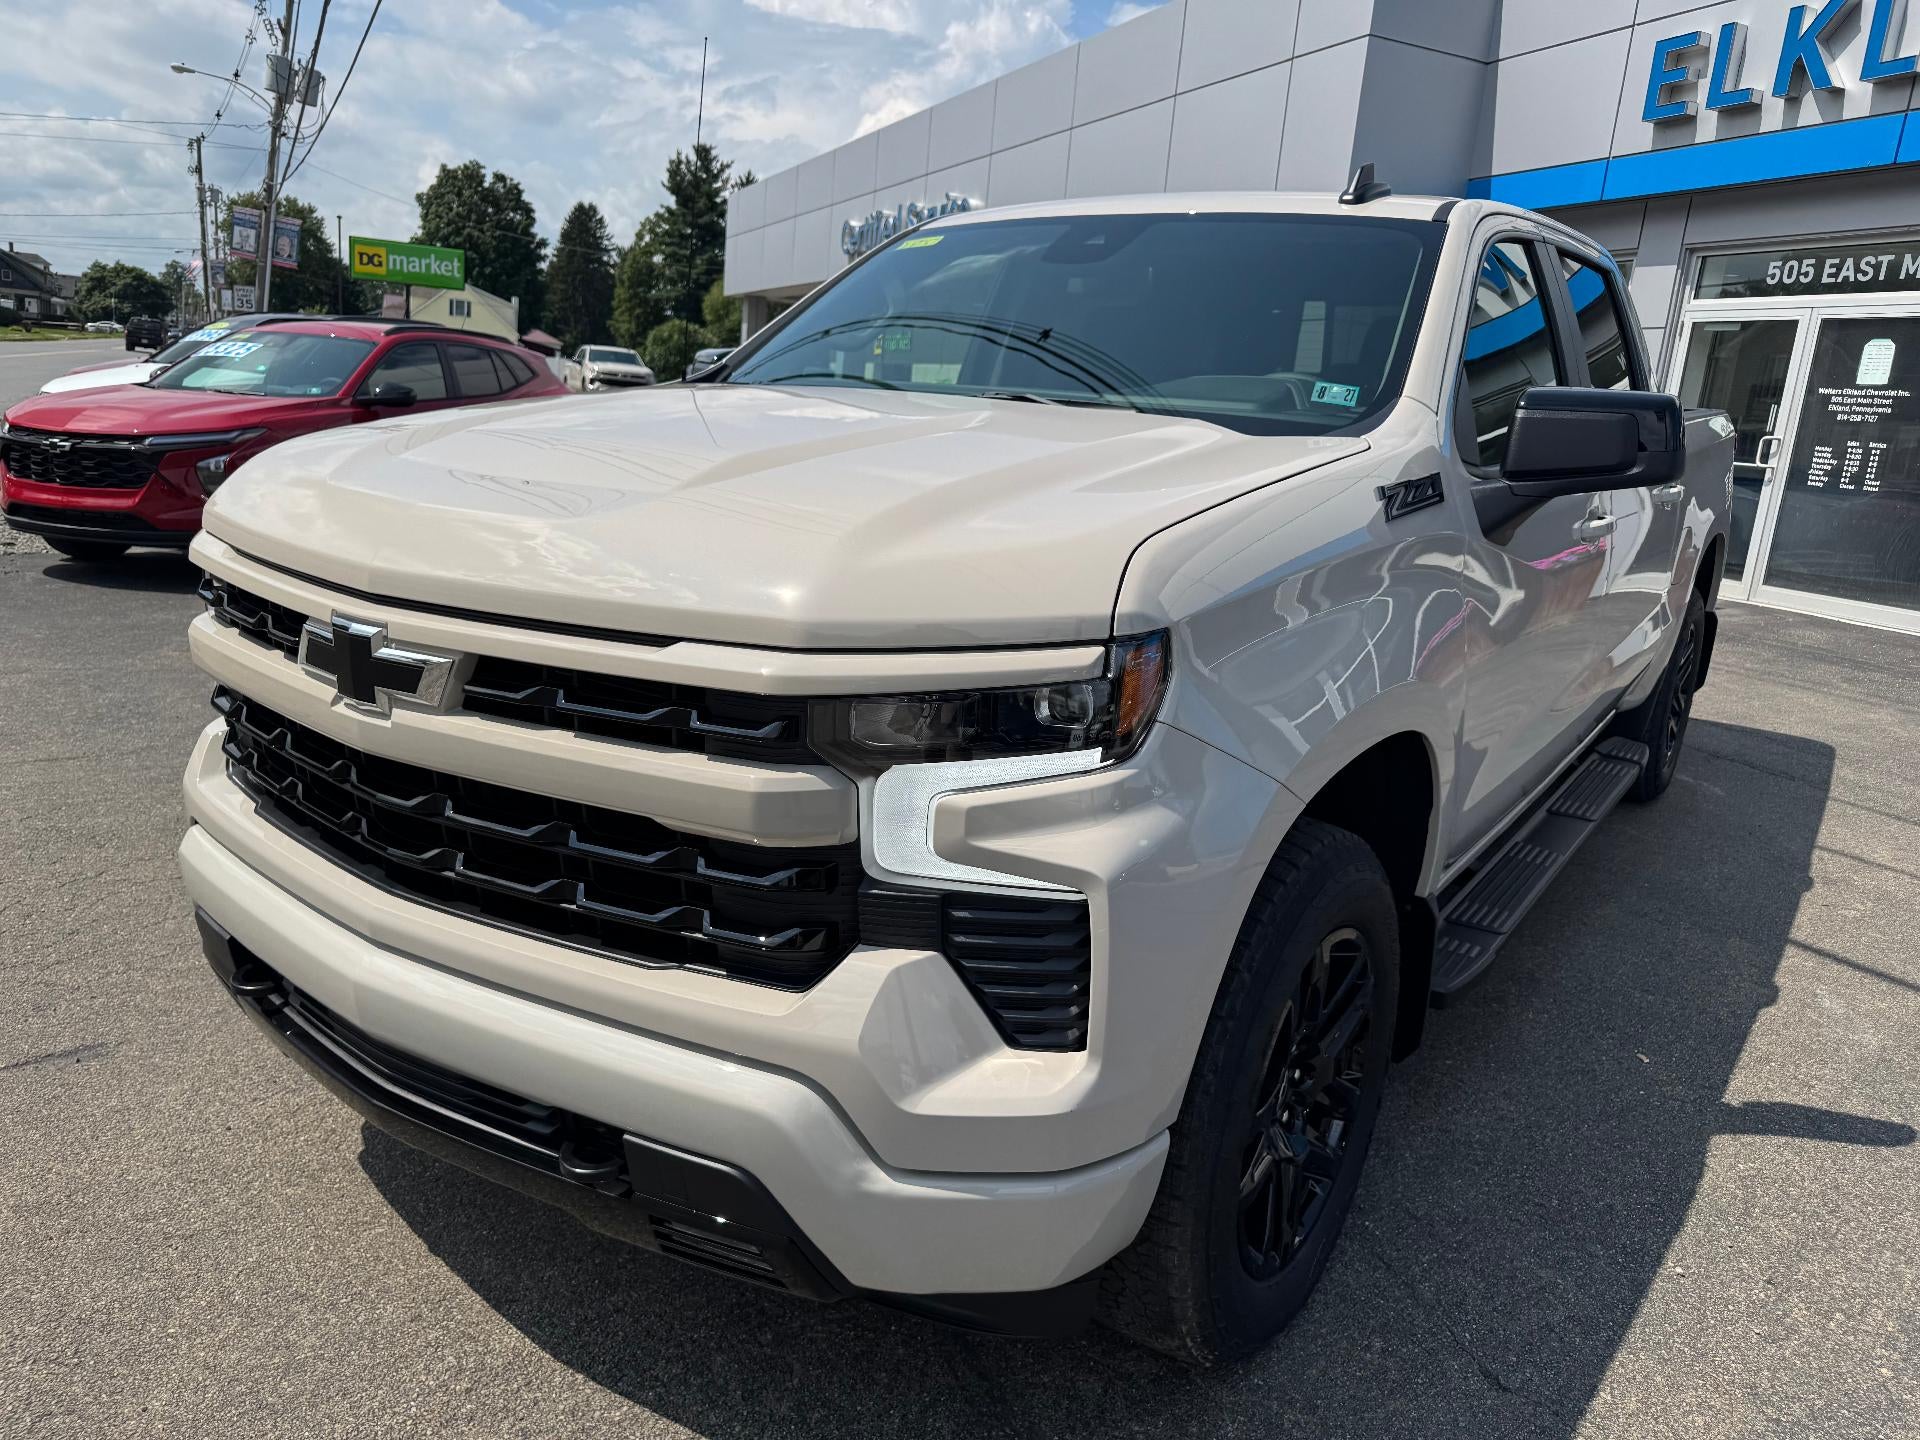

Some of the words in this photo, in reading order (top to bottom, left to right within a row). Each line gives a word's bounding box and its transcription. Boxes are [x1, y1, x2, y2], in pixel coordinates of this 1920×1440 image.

[358, 251, 383, 268] DG
[389, 254, 461, 278] market
[1766, 258, 1816, 285] 505
[1821, 254, 1896, 284] EAST
[236, 298, 254, 309] 35
[1343, 388, 1356, 403] 27
[1866, 389, 1897, 397] Chevrolet
[1374, 472, 1444, 523] Z71
